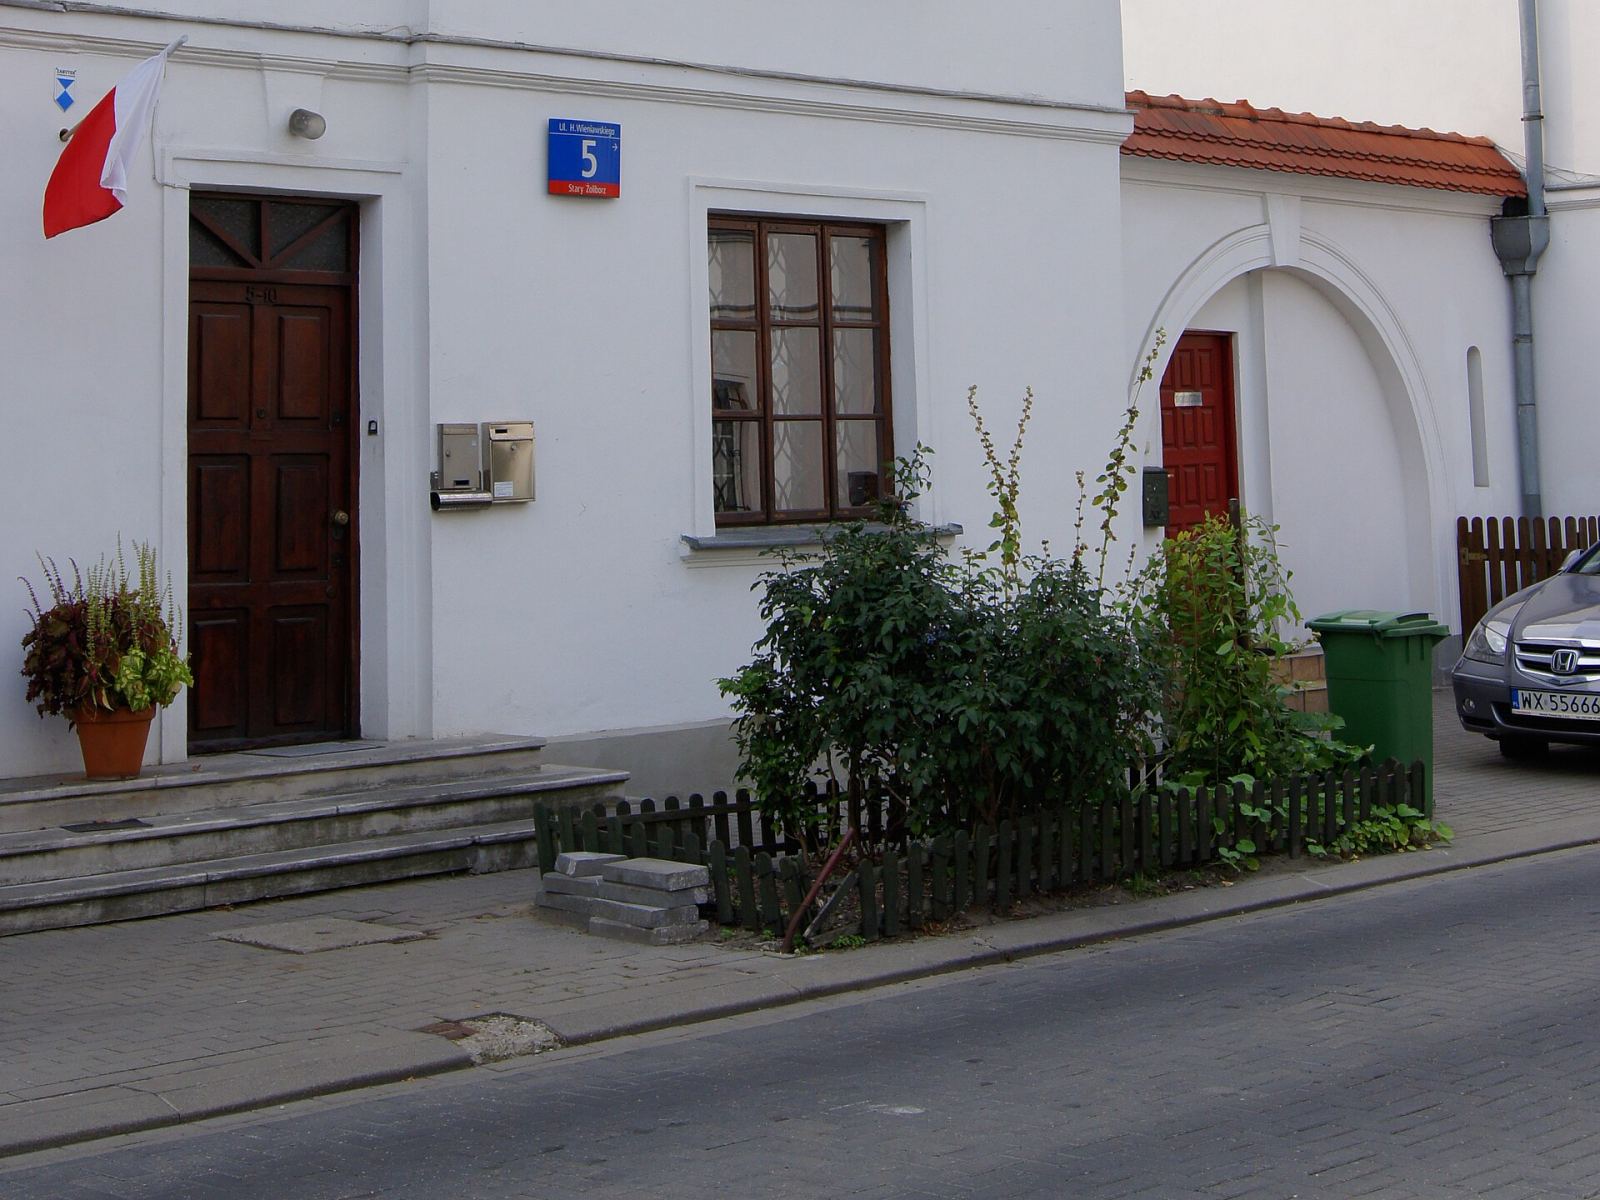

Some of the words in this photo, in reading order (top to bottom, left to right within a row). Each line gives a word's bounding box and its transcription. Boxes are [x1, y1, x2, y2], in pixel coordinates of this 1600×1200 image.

[581, 139, 598, 178] 5
[568, 183, 584, 195] Stary
[1521, 692, 1544, 710] WX
[1549, 694, 1600, 714] 55666
